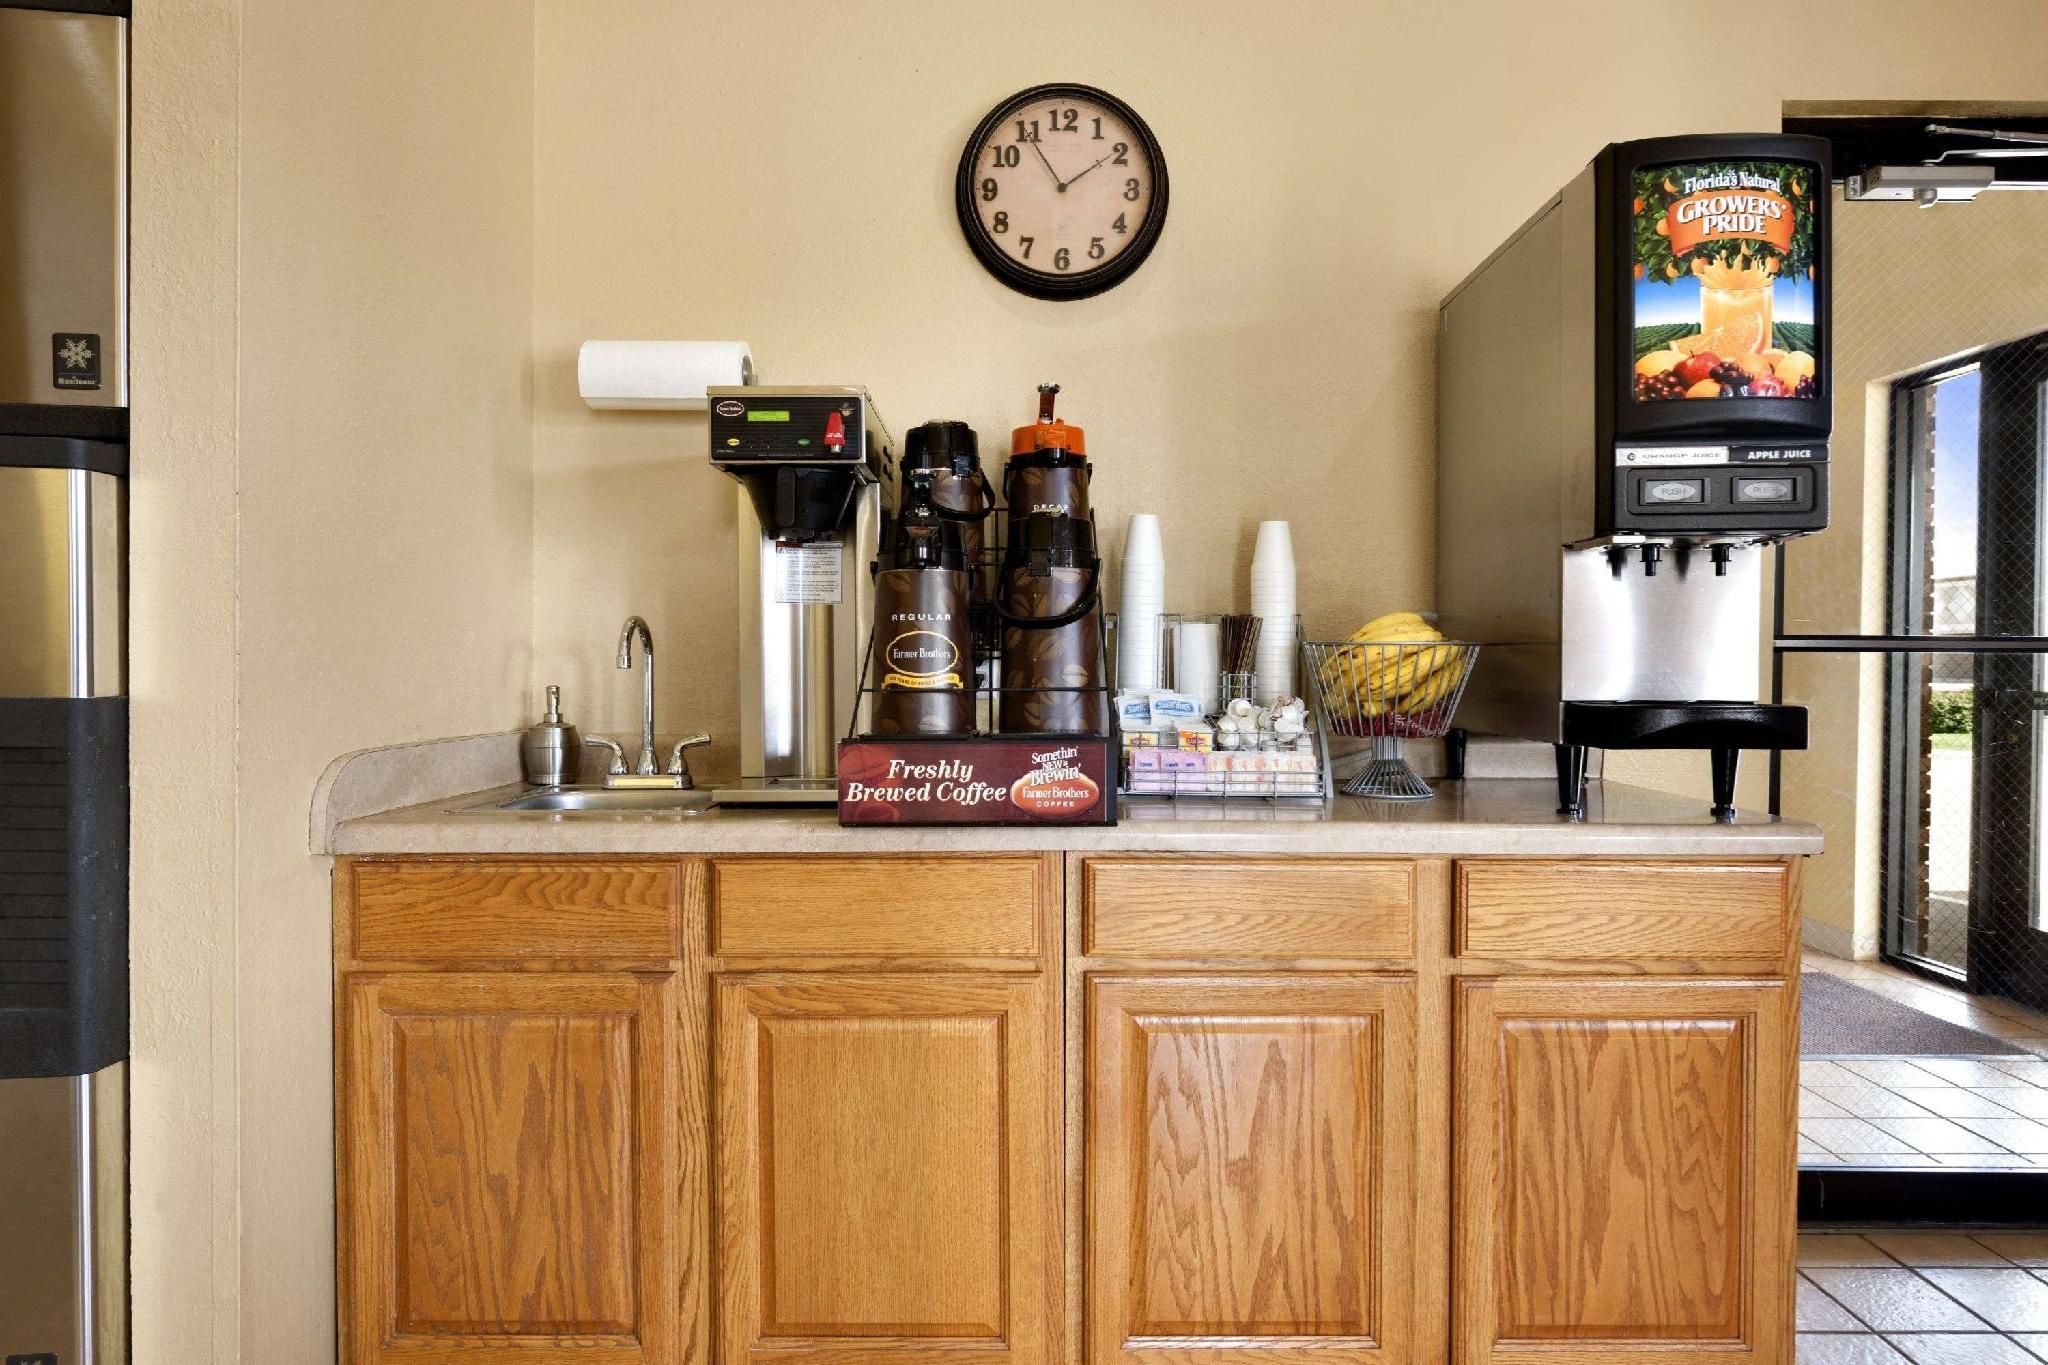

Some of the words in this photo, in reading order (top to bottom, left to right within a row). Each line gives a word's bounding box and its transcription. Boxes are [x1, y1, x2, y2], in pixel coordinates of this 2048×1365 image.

[1015, 120, 1042, 143] 11
[1048, 108, 1078, 132] 12
[1091, 116, 1104, 140] 1
[992, 145, 1020, 168] 10
[1112, 142, 1129, 167] 2
[981, 177, 998, 201] 9
[1123, 178, 1140, 201] 3
[1683, 172, 1738, 194] Florida's
[1739, 172, 1781, 193] Natural
[992, 211, 1009, 234] 8
[1112, 212, 1127, 234] 4
[1702, 213, 1767, 236] PRIDE
[1019, 235, 1035, 259] 7
[1087, 237, 1105, 260] 5
[1054, 247, 1071, 271] 6
[1747, 451, 1780, 460] APPLE
[1783, 449, 1812, 459] JUICE
[1661, 488, 1687, 496] PUSH
[891, 613, 951, 621] REGULAR
[893, 648, 919, 659] Farmer
[919, 647, 951, 658] Brothers
[1031, 745, 1079, 765] Somethin'
[1042, 760, 1062, 772] NEW
[886, 759, 974, 782] Freshly
[1029, 762, 1082, 787] Brewin'
[844, 782, 931, 802] Brewed
[936, 781, 1007, 806] Coffee
[1022, 786, 1051, 799] Farmer
[1052, 786, 1089, 799] Brothers
